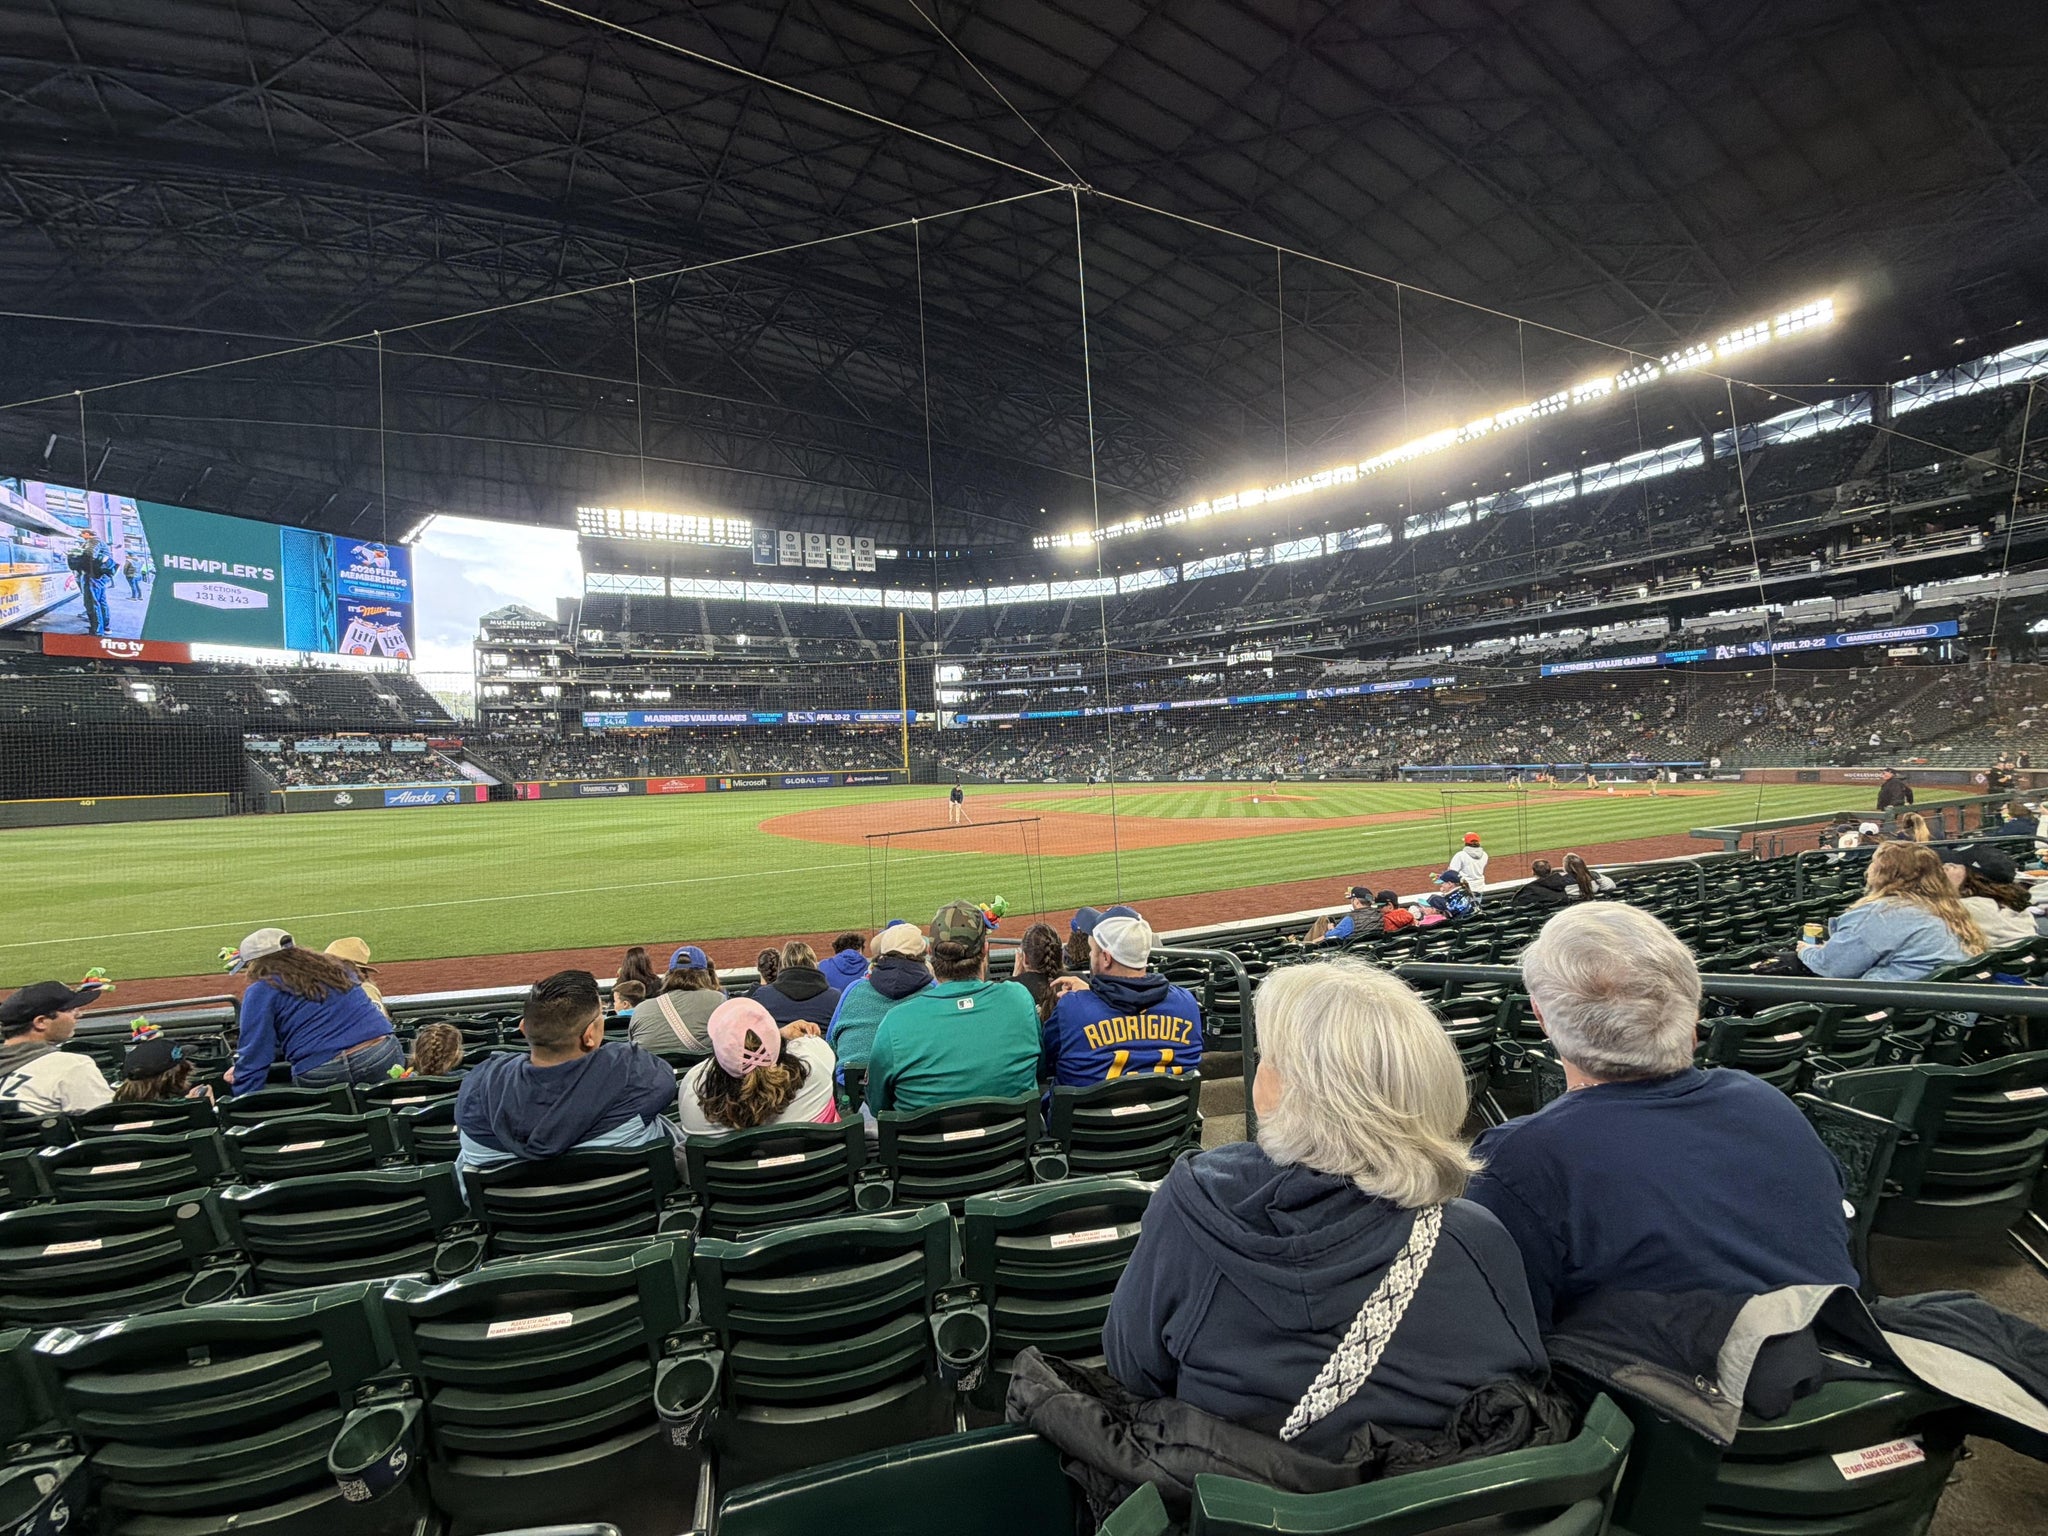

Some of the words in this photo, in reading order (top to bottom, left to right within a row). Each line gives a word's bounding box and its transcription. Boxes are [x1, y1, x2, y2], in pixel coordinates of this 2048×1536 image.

[164, 554, 275, 580] HEMPLER'S
[350, 564, 375, 574] 2026
[376, 568, 398, 578] FLEX
[340, 570, 408, 587] MEMBERSHIPS
[203, 585, 242, 594] SECTIONS
[196, 592, 214, 601] 131
[230, 596, 249, 604] 143
[1846, 628, 1928, 642] MARINERS.COM/VALUE
[100, 638, 127, 650] fire
[128, 641, 144, 651] tv
[1772, 642, 1798, 651] APRIL
[1798, 638, 1826, 649] 20-22
[1551, 662, 1594, 673] MARINERS
[1594, 659, 1623, 669] VALUE
[1623, 656, 1657, 666] GAMES
[644, 714, 689, 722] MARINERS
[717, 714, 747, 722] GAMES
[733, 778, 767, 787] Microsoft
[390, 790, 437, 804] Alaska
[1083, 1008, 1193, 1050] RODRÍGUEZ
[1860, 1450, 1880, 1460] PLEASE
[1880, 1446, 1893, 1456] STAY
[1842, 1466, 1851, 1474] TO
[1851, 1464, 1865, 1473] BATS
[1864, 1462, 1877, 1470] AND
[1876, 1457, 1892, 1466] BALLS
